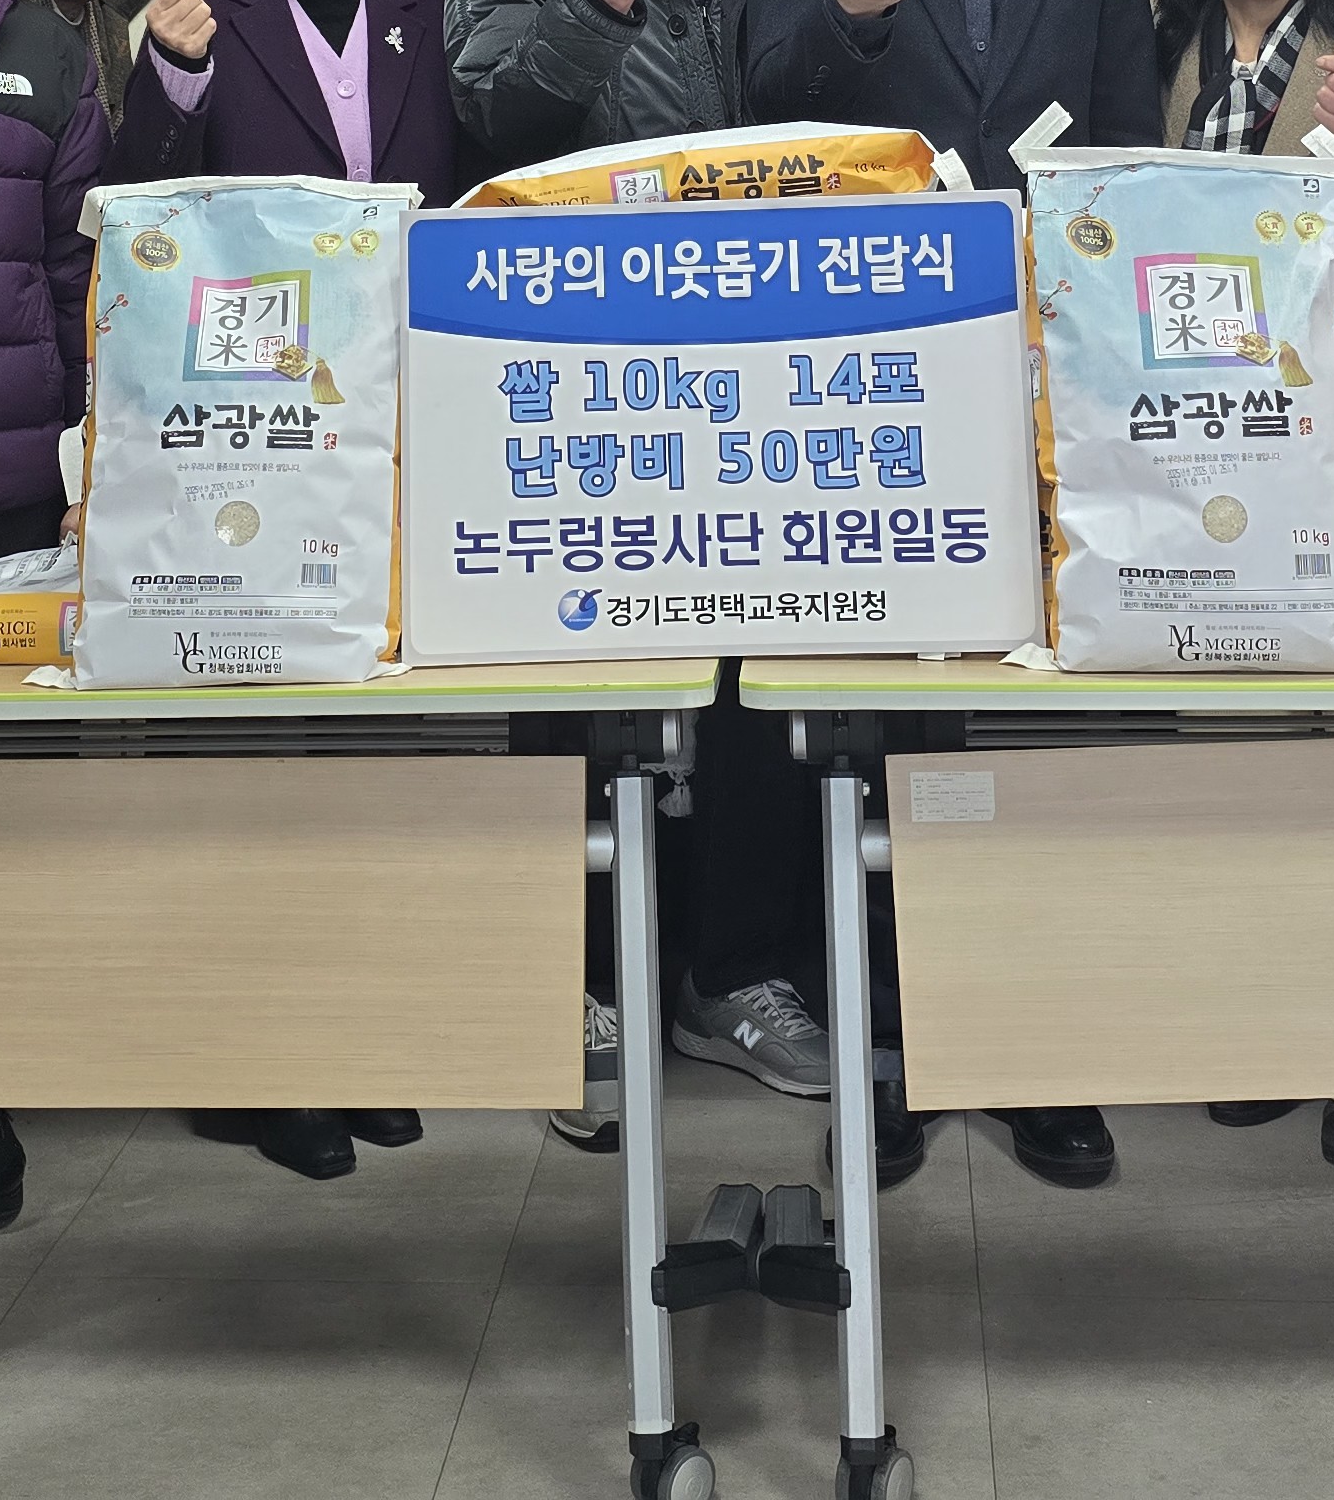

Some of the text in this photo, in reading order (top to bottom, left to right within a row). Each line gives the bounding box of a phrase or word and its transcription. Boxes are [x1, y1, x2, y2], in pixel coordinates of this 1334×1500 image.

[620, 174, 658, 196] 경기
[680, 154, 825, 200] 삼광쌀
[145, 248, 168, 258] 100%
[1080, 236, 1104, 246] 100%
[467, 233, 954, 305] 사랑의 이웃돕기 전달식
[1158, 272, 1243, 312] 경기
[210, 290, 289, 331] 경기
[207, 333, 248, 366] 米
[1165, 314, 1208, 351] 米
[499, 350, 925, 423] 쌀 10kg 14포
[161, 403, 320, 450] 삼광쌀
[1130, 390, 1294, 441] 삼광쌀
[505, 425, 927, 498] 난방비 50만원
[1167, 454, 1192, 463] 우리나라
[303, 539, 338, 557] 10 kg
[453, 507, 990, 576] 논두렁봉사단 회원일동
[1292, 529, 1330, 546] 10 kg
[606, 590, 887, 627] 경기도평택교육지원청
[208, 645, 283, 660] MGRICE
[1205, 638, 1281, 651] MGRICE
[1205, 652, 1280, 661] 청북농업회사법인
[208, 662, 282, 674] 청북농업회사법인
